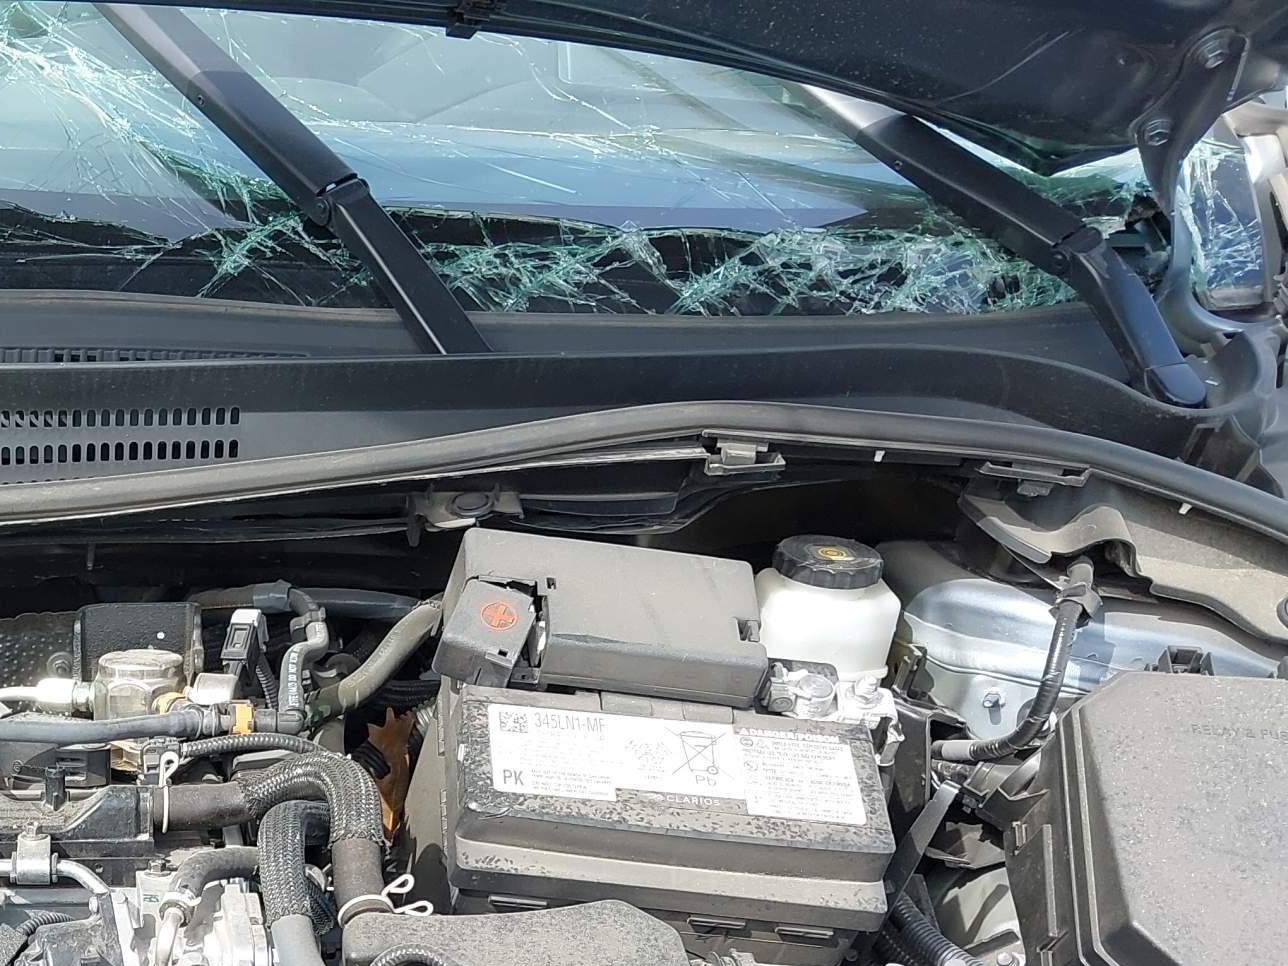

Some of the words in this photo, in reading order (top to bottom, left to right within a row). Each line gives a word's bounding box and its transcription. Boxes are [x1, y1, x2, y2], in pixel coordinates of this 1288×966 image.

[534, 712, 605, 732] 345LN1-MF
[1191, 723, 1240, 737] RELAY
[502, 769, 525, 786] PK
[695, 775, 717, 786] Pb
[666, 794, 721, 806] CLARIOS
